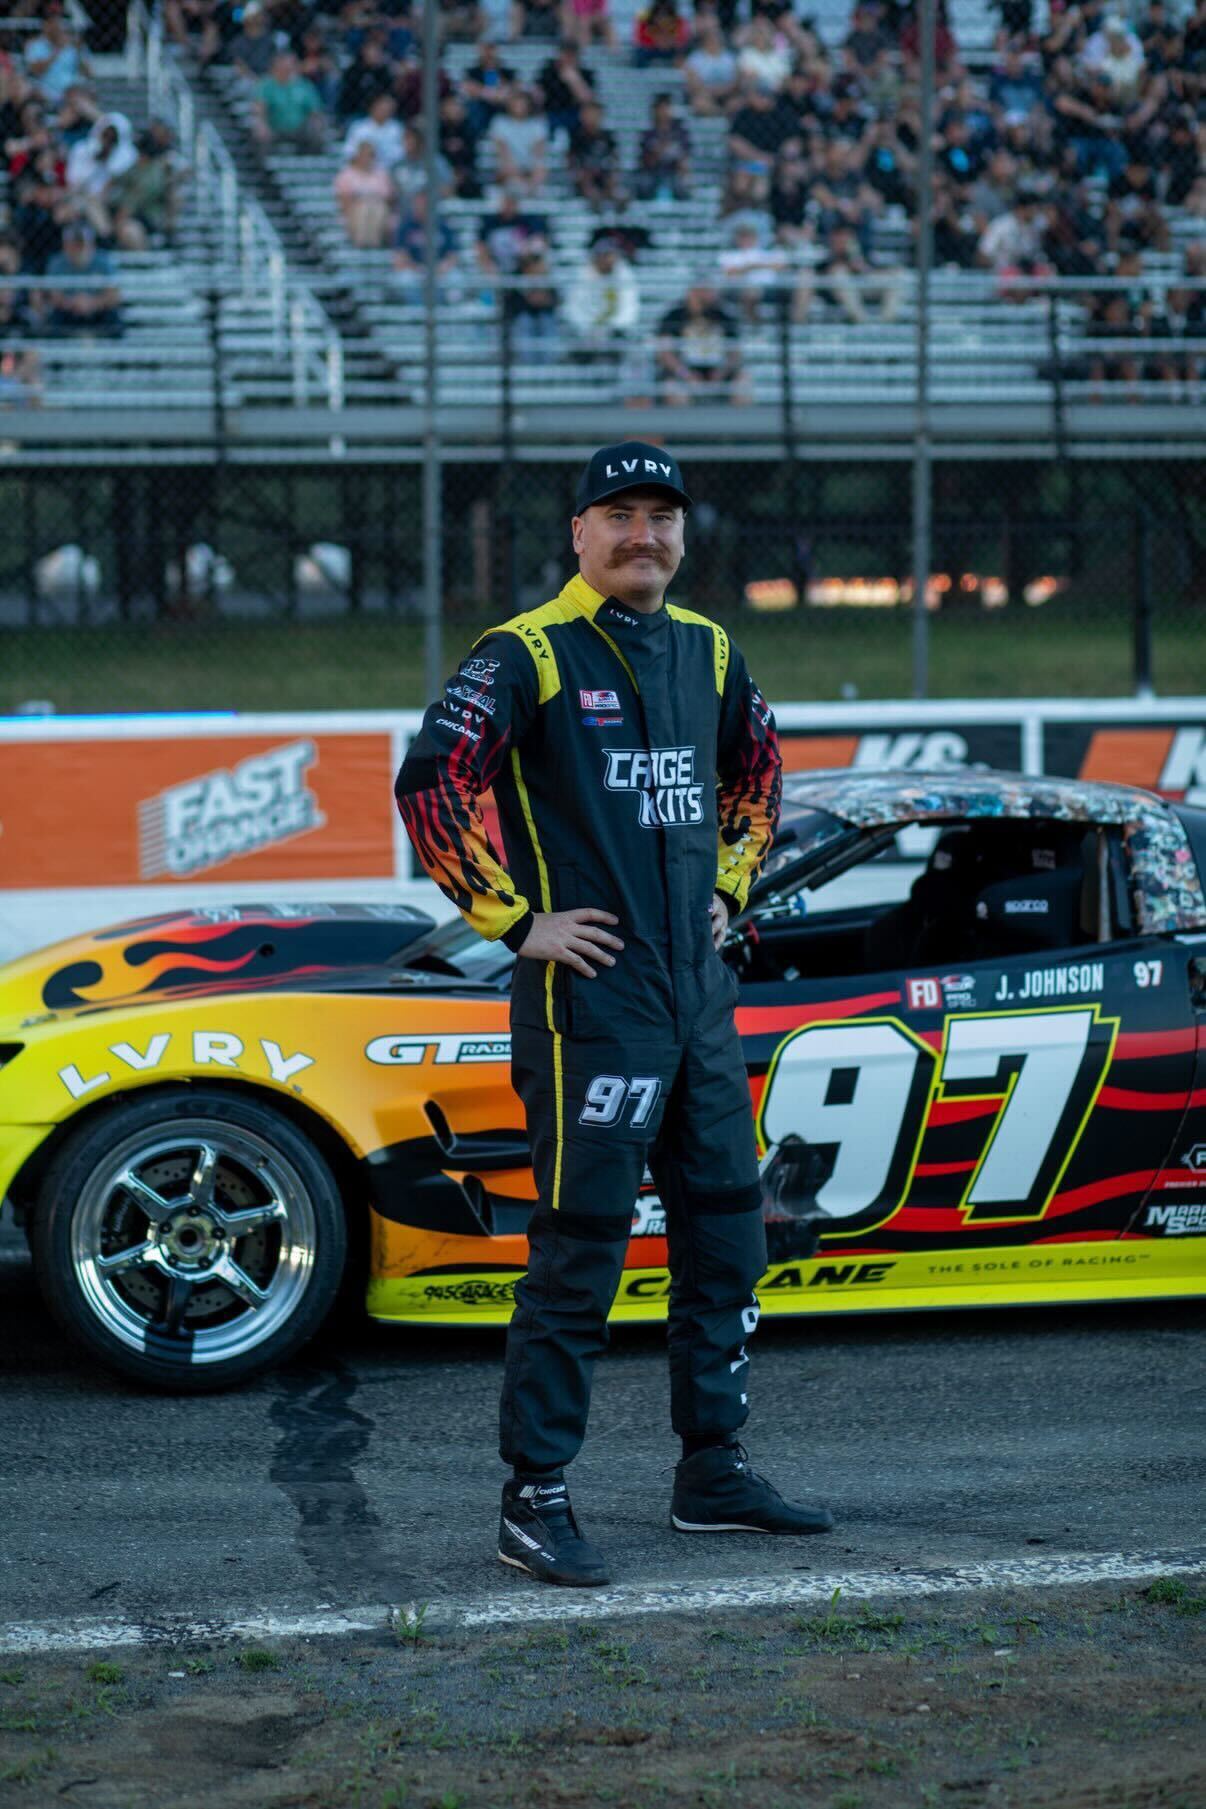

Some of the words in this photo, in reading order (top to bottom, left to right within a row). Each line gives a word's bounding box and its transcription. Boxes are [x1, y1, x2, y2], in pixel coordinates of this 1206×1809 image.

[606, 459, 671, 478] LVRY
[609, 608, 638, 627] LVRY
[517, 624, 549, 660] LVRY
[436, 718, 482, 741] CHICANE
[607, 750, 693, 789] CAGE
[164, 741, 314, 838] FAST
[640, 787, 703, 825] KITS
[995, 975, 1014, 1001] J.
[1019, 963, 1104, 999] JOHNSON
[1133, 960, 1163, 988] 97
[910, 979, 938, 1007] FD
[58, 1031, 315, 1100] LVRY
[579, 1075, 661, 1128] 97
[760, 1007, 1098, 1220] 97
[928, 1264, 964, 1274] THE
[972, 1260, 1021, 1272] SOLE
[1029, 1258, 1054, 1269] OF
